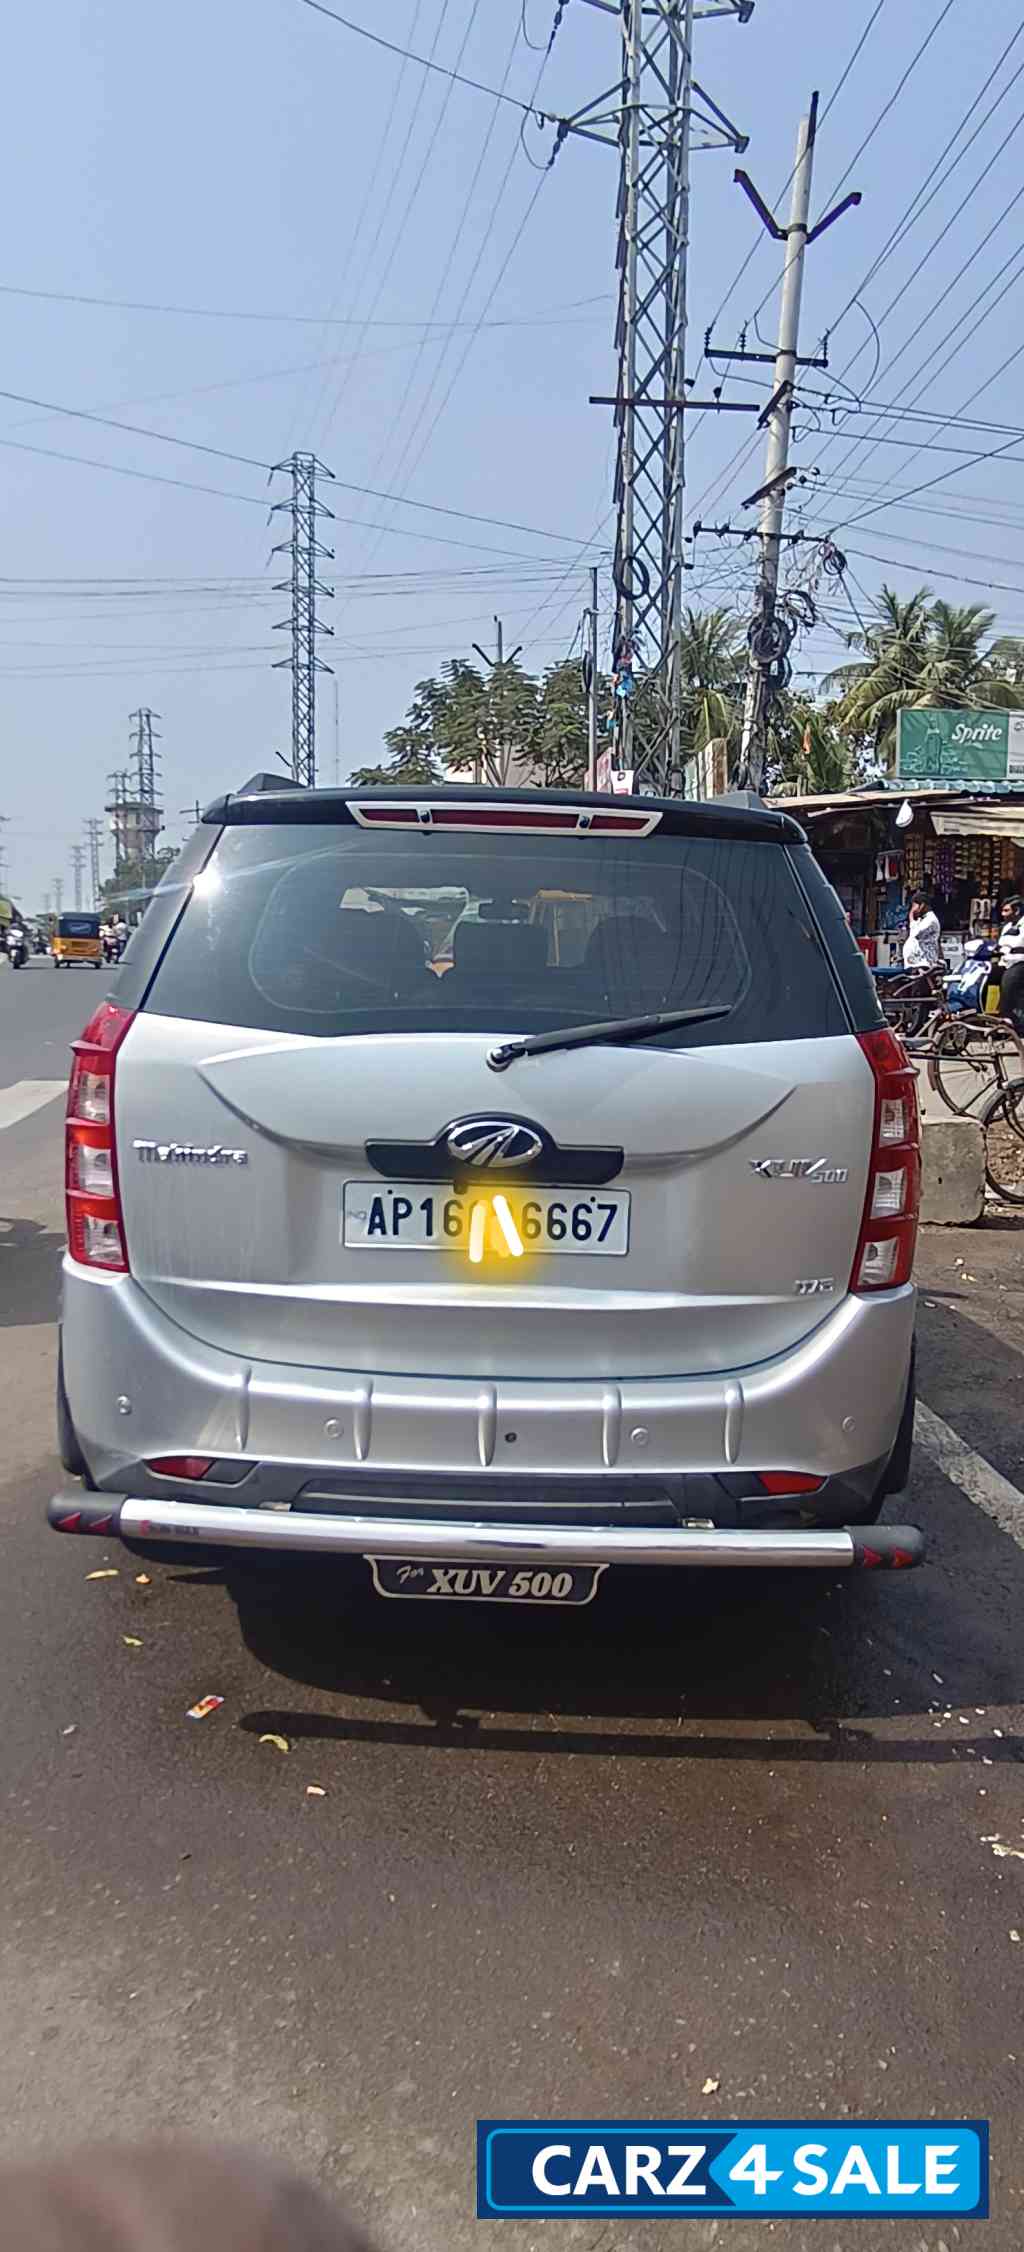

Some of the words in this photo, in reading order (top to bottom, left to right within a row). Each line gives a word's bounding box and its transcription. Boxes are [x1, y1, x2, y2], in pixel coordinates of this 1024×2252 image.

[952, 723, 1002, 743] Sprite
[812, 1168, 848, 1183] 500
[367, 1196, 618, 1243] AP166667
[426, 1569, 506, 1595] XUV
[508, 1572, 573, 1598] 500
